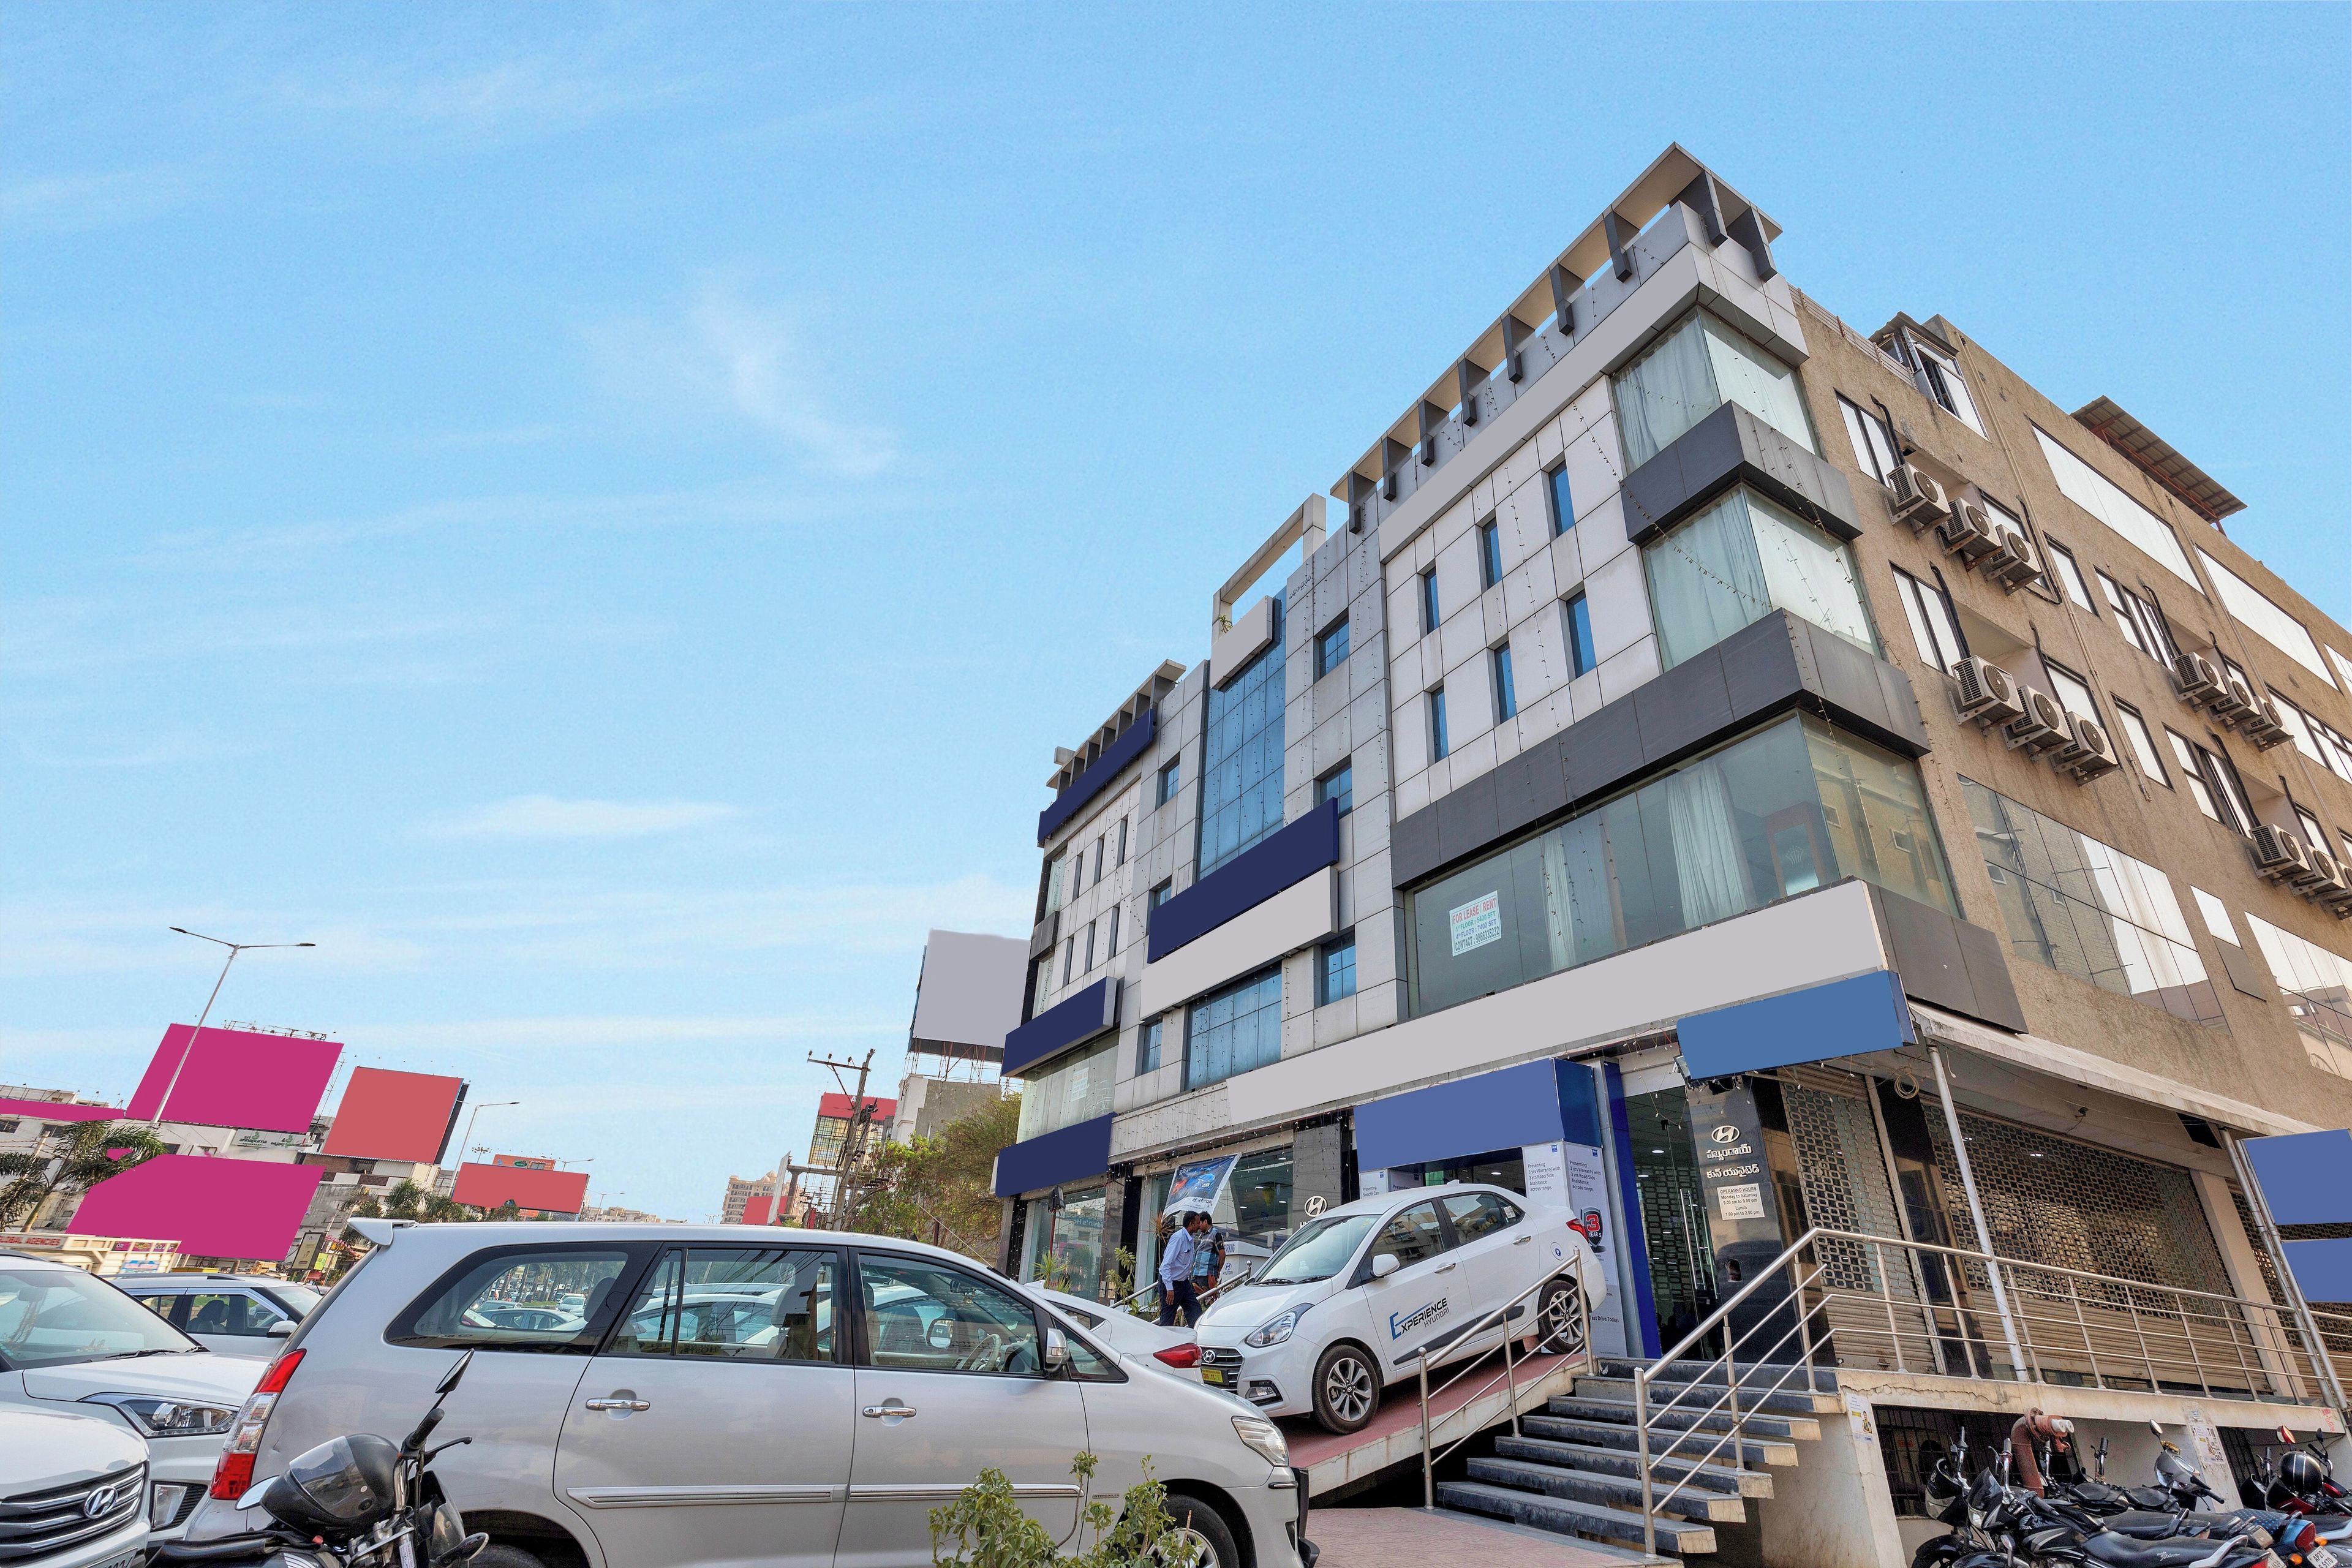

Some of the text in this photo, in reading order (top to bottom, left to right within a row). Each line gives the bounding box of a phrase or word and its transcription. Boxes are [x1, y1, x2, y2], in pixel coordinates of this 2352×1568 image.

[1453, 912, 1463, 924] FOR
[1463, 905, 1479, 919] LEASE
[1483, 898, 1496, 911] RENT
[1460, 920, 1474, 930] FLOOR
[1477, 914, 1487, 922] 5400
[1461, 928, 1474, 937] FLOOR
[1477, 922, 1487, 931] 7400
[1455, 937, 1472, 951] CONTACT
[1476, 926, 1499, 943] 9866335232
[1586, 1214, 1600, 1232] 3
[0, 1235, 60, 1246] LOBAL AGENCIES
[1389, 1297, 1447, 1341] EXPERIENCE
[1423, 1306, 1450, 1328] HYUNDAI
[2313, 1551, 2324, 1562] AP27
